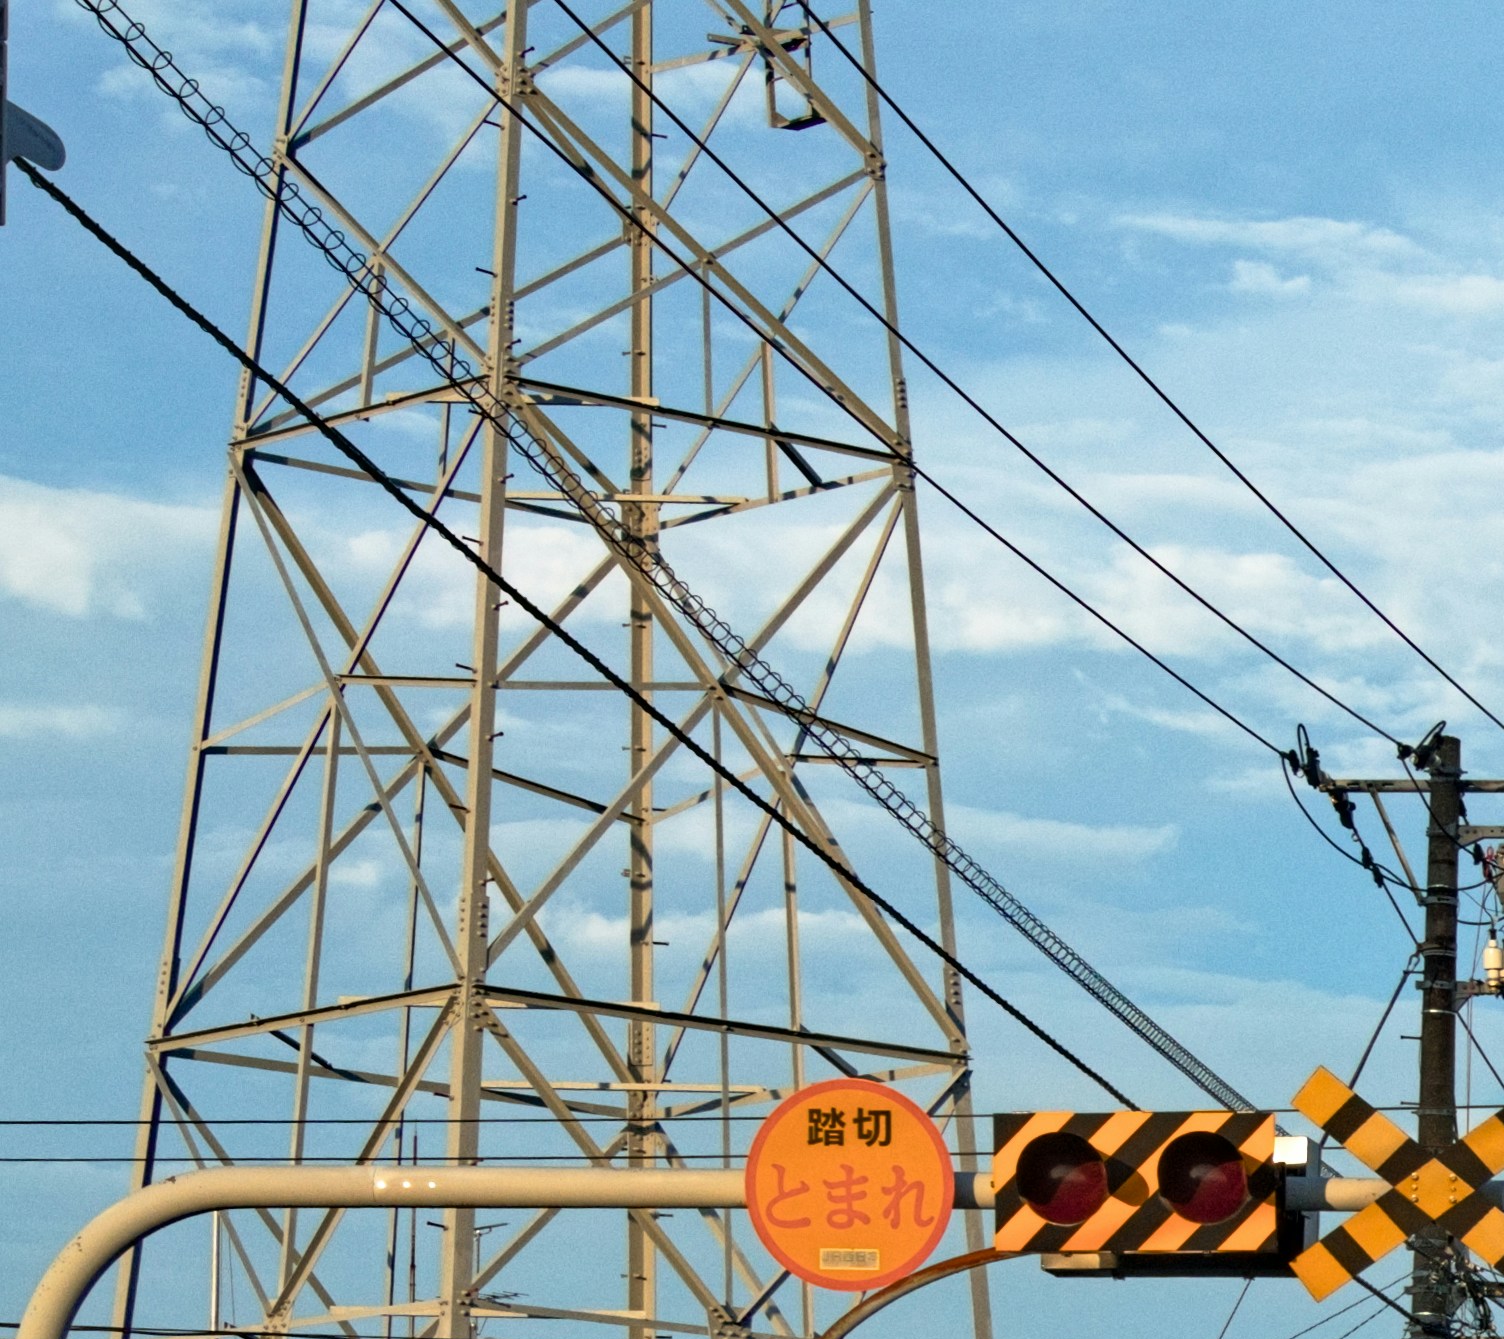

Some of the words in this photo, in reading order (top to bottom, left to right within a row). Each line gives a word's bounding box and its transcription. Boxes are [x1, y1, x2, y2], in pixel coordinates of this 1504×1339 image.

[807, 1107, 891, 1146] 踏切
[765, 1163, 935, 1230] とまれ
